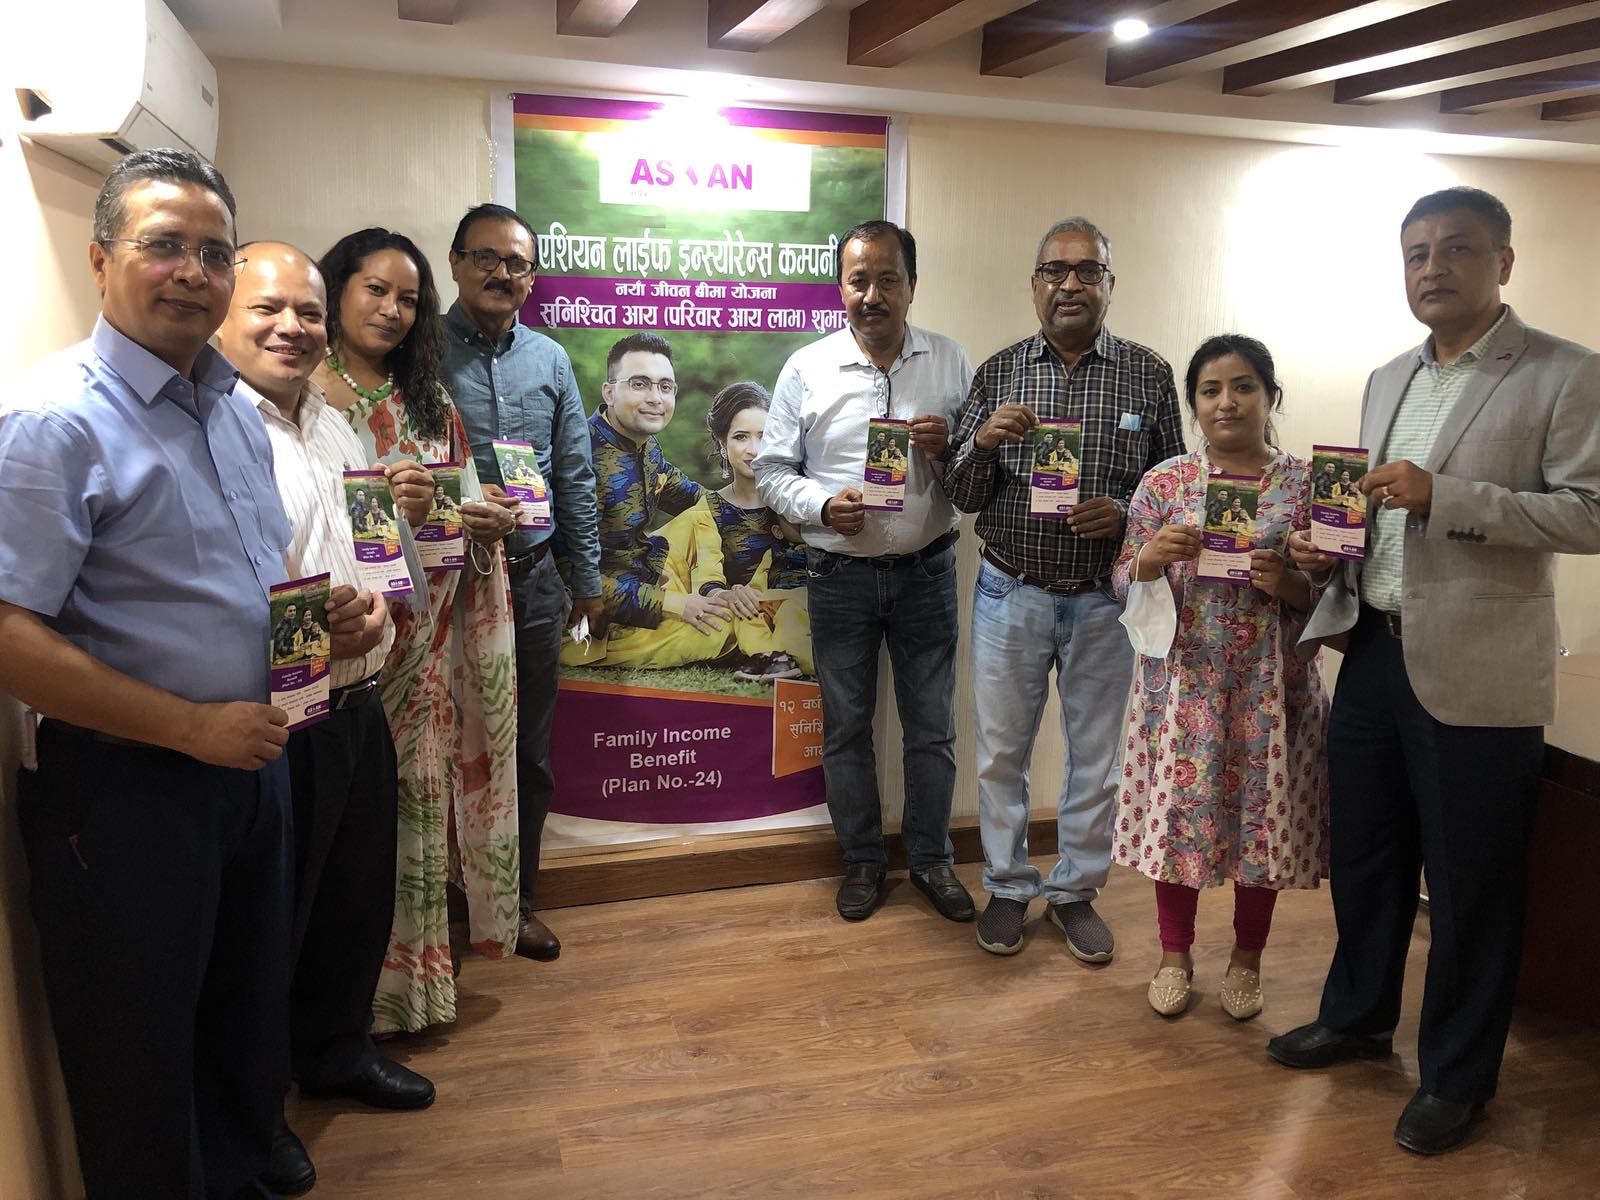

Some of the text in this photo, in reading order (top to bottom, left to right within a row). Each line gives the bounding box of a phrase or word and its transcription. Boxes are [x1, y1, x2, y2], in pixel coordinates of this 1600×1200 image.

[538, 221, 607, 273] एशियन
[612, 228, 673, 278] लाईफ
[651, 281, 691, 298] जीवन
[695, 282, 727, 299] बीमा
[731, 283, 777, 300] योजना
[540, 296, 617, 330] सुनिश्चित
[622, 305, 659, 327] आय
[664, 299, 723, 328] (परिवार
[728, 307, 763, 328] आय
[767, 309, 806, 329] लाभ)
[779, 700, 796, 714] १२
[593, 726, 732, 748] Family Income
[629, 749, 697, 769] Benefit
[601, 769, 722, 798] (Plan No.-24)
